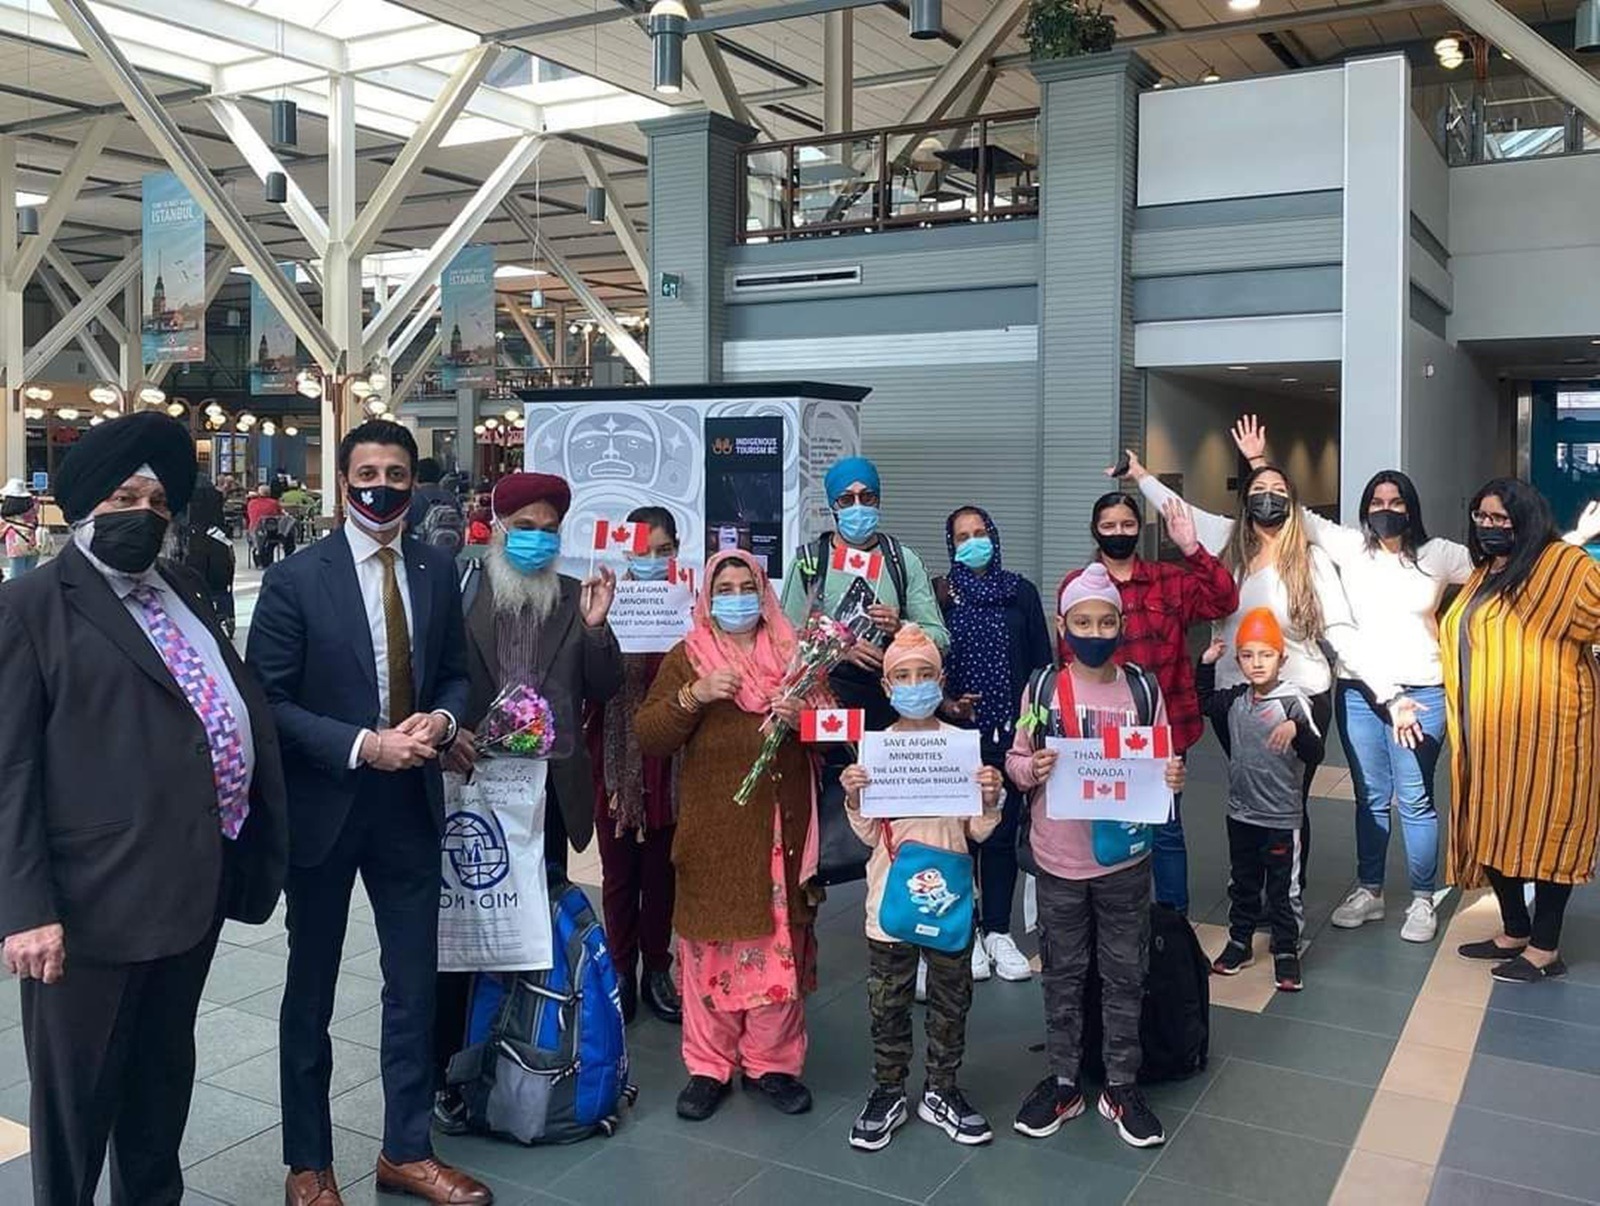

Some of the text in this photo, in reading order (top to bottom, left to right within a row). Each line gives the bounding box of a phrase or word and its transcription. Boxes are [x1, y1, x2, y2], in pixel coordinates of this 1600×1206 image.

[151, 207, 193, 223] ISTANBUL
[736, 446, 778, 454] TOURISM BC
[619, 597, 665, 605] MINORITIES
[884, 738, 947, 747] SAVE AFGHAN
[888, 752, 943, 760] MINORITIES
[1074, 750, 1103, 760] THAN
[909, 766, 927, 774] MLA
[1077, 767, 1124, 777] CANADA
[479, 892, 518, 909] OIM
